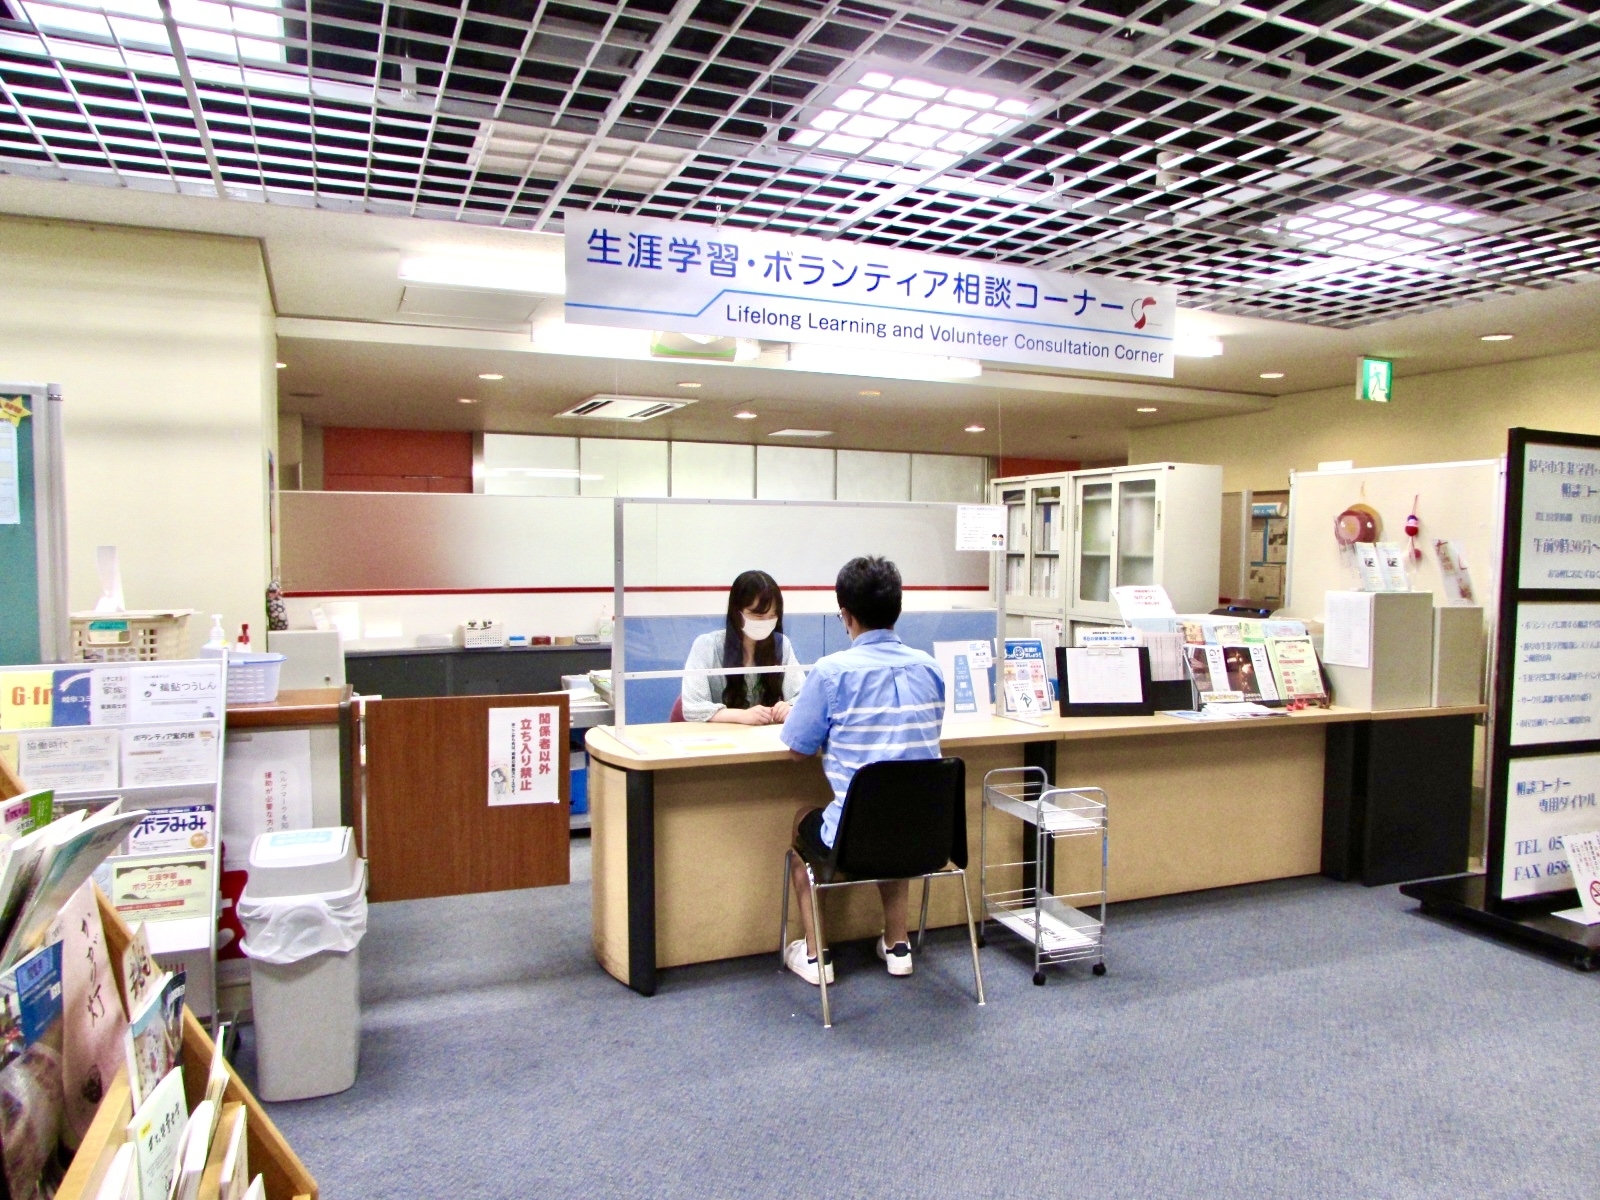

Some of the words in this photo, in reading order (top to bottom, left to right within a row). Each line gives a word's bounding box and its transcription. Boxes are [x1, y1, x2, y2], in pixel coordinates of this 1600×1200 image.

[586, 228, 1124, 316] 生涯学習・ボランティア相談コーナー
[726, 304, 802, 330] Lifelong
[808, 312, 887, 338] Learning
[893, 324, 924, 339] and
[930, 324, 1009, 348] Volunteer
[1014, 333, 1109, 357] Consultation
[1115, 344, 1164, 364] Corner
[520, 719, 533, 791] 立ち入り禁止
[538, 713, 551, 775] 関係者以外
[133, 814, 207, 839] ボラみみ
[1515, 839, 1541, 856] TEL
[1514, 863, 1541, 881] FAX
